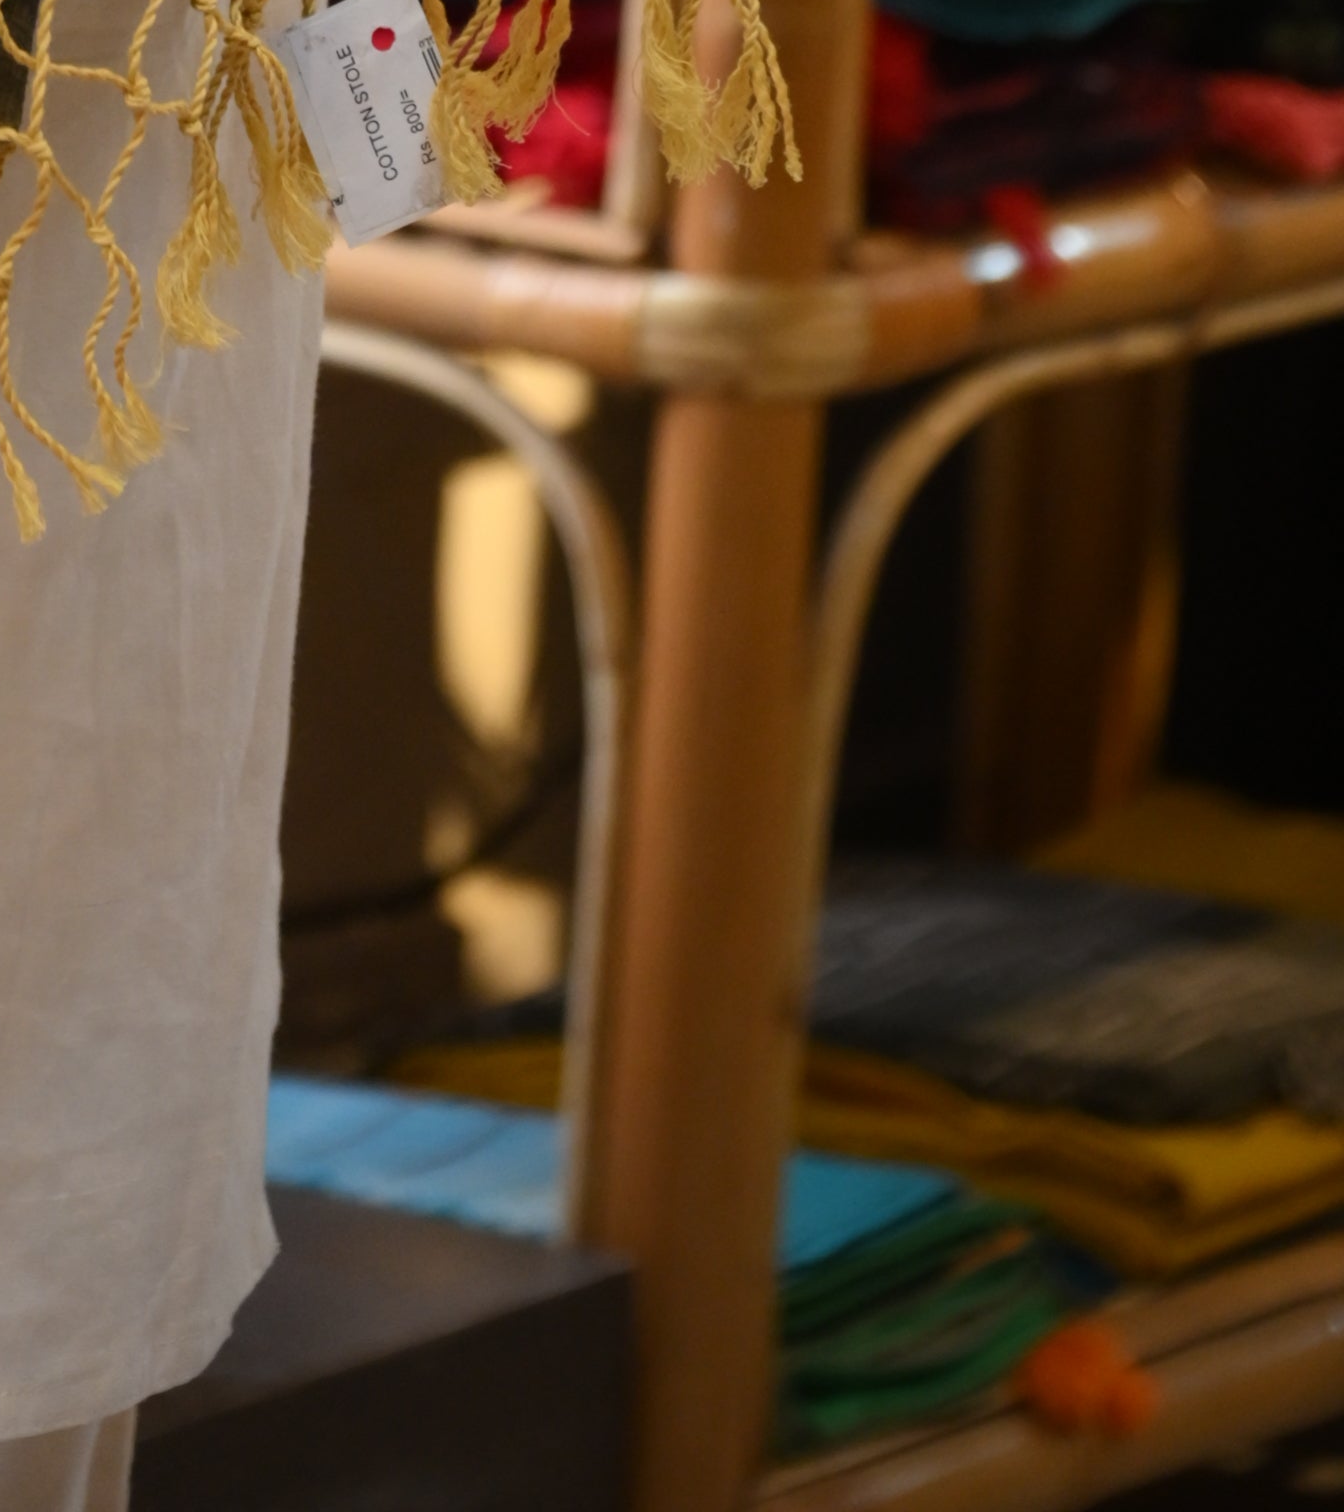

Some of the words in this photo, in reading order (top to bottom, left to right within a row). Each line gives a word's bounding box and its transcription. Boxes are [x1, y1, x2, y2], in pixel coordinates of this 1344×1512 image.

[336, 44, 369, 105] STOLE
[400, 88, 425, 134] 800/=
[360, 106, 399, 181] COTTON
[420, 136, 437, 165] Rs.
